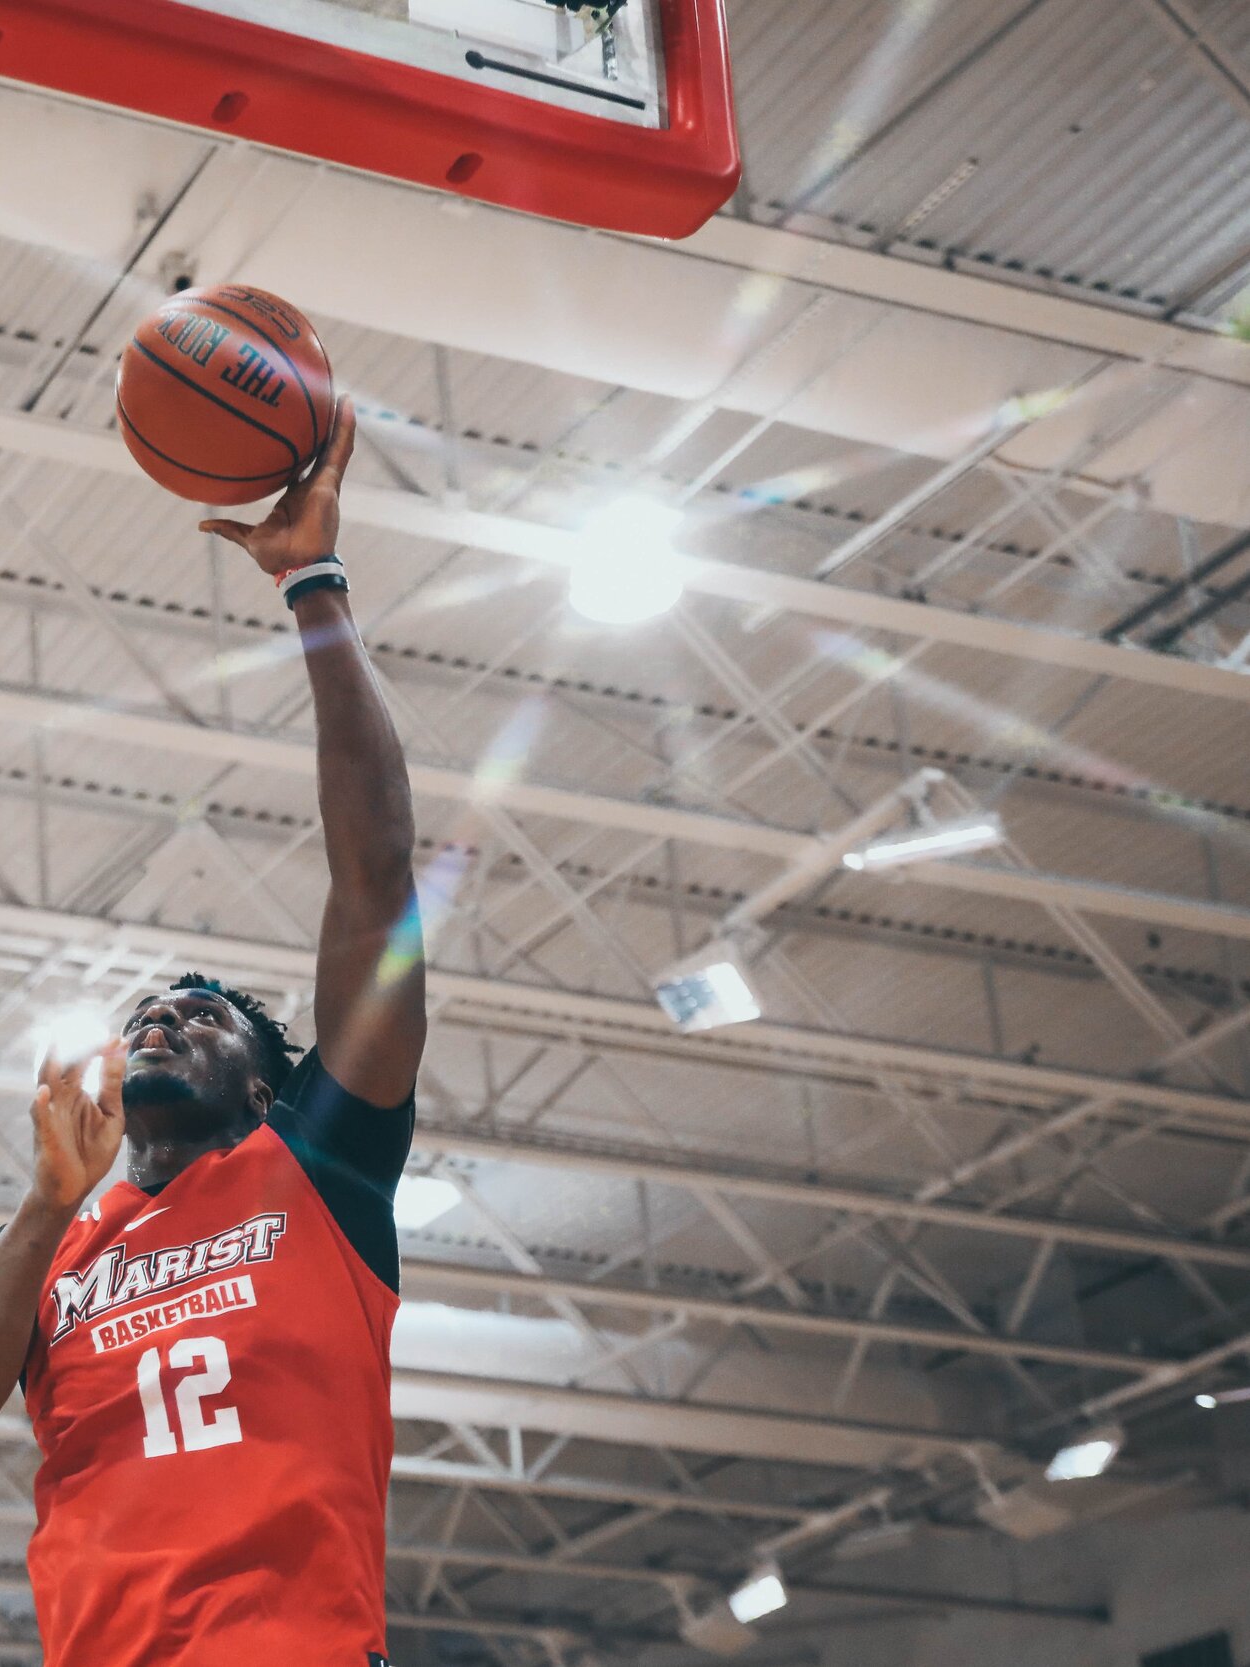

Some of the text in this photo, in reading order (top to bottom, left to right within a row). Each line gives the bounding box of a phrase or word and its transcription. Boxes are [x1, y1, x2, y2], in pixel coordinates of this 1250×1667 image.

[156, 311, 286, 408] THE ROCK
[98, 1282, 248, 1349] BASKETBALL
[136, 1336, 243, 1459] 12
